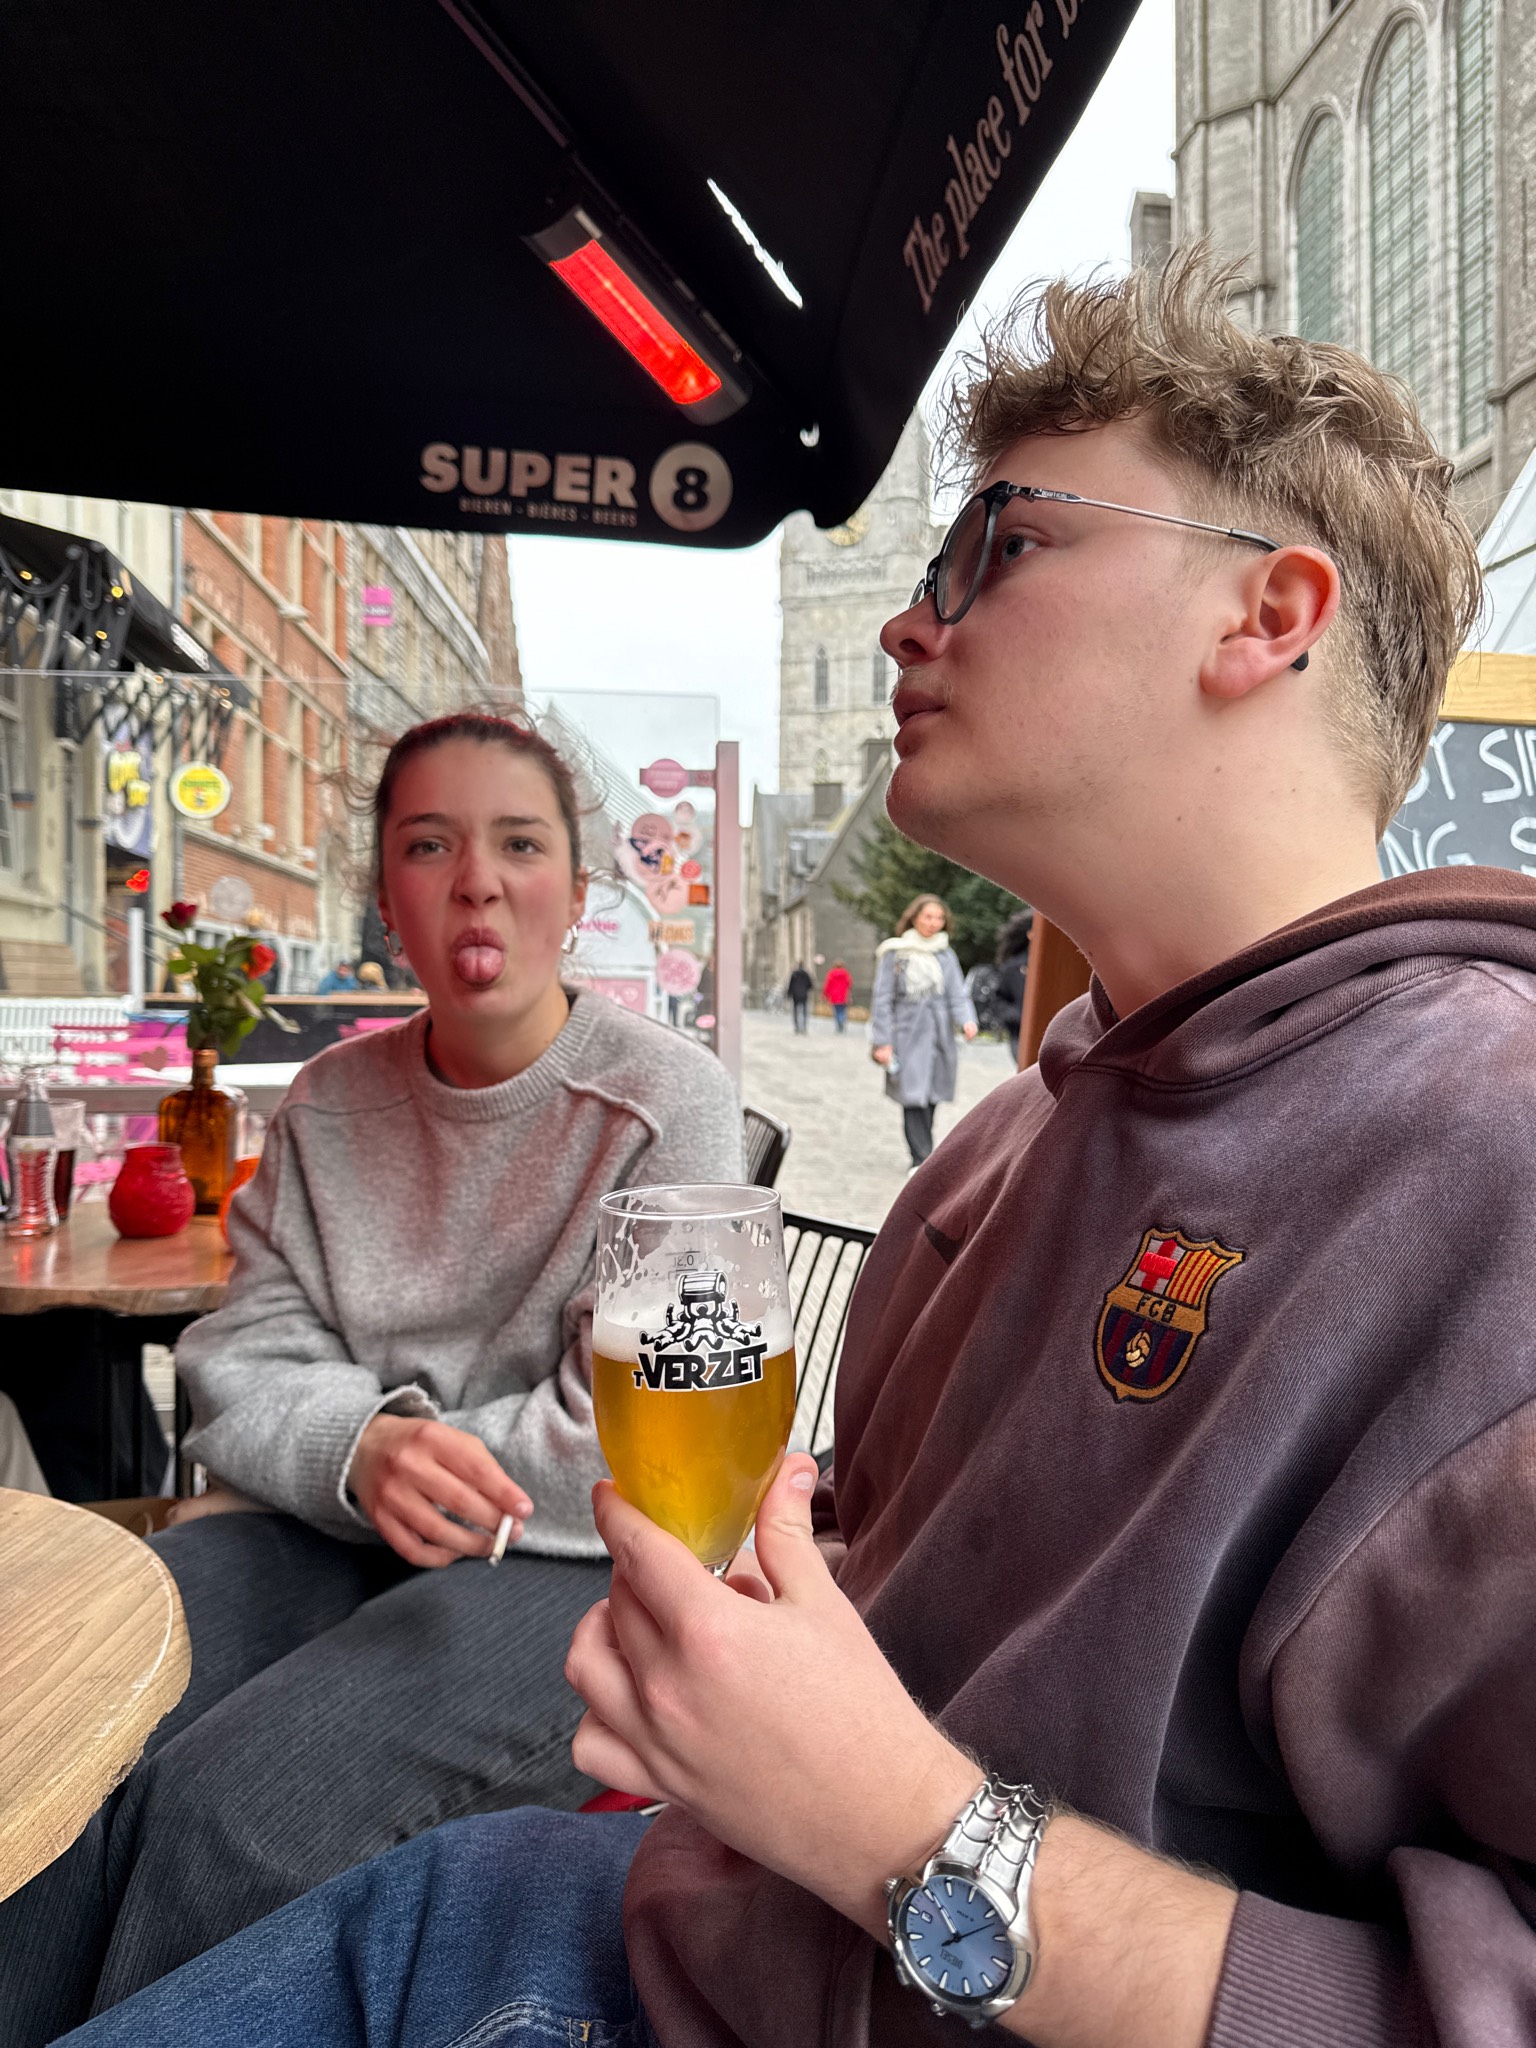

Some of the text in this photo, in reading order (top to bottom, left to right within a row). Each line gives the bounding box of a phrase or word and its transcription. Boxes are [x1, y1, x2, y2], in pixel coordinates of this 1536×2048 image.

[903, 0, 1054, 314] The place for
[419, 442, 711, 513] SUPER 8
[1137, 1293, 1176, 1323] FCB
